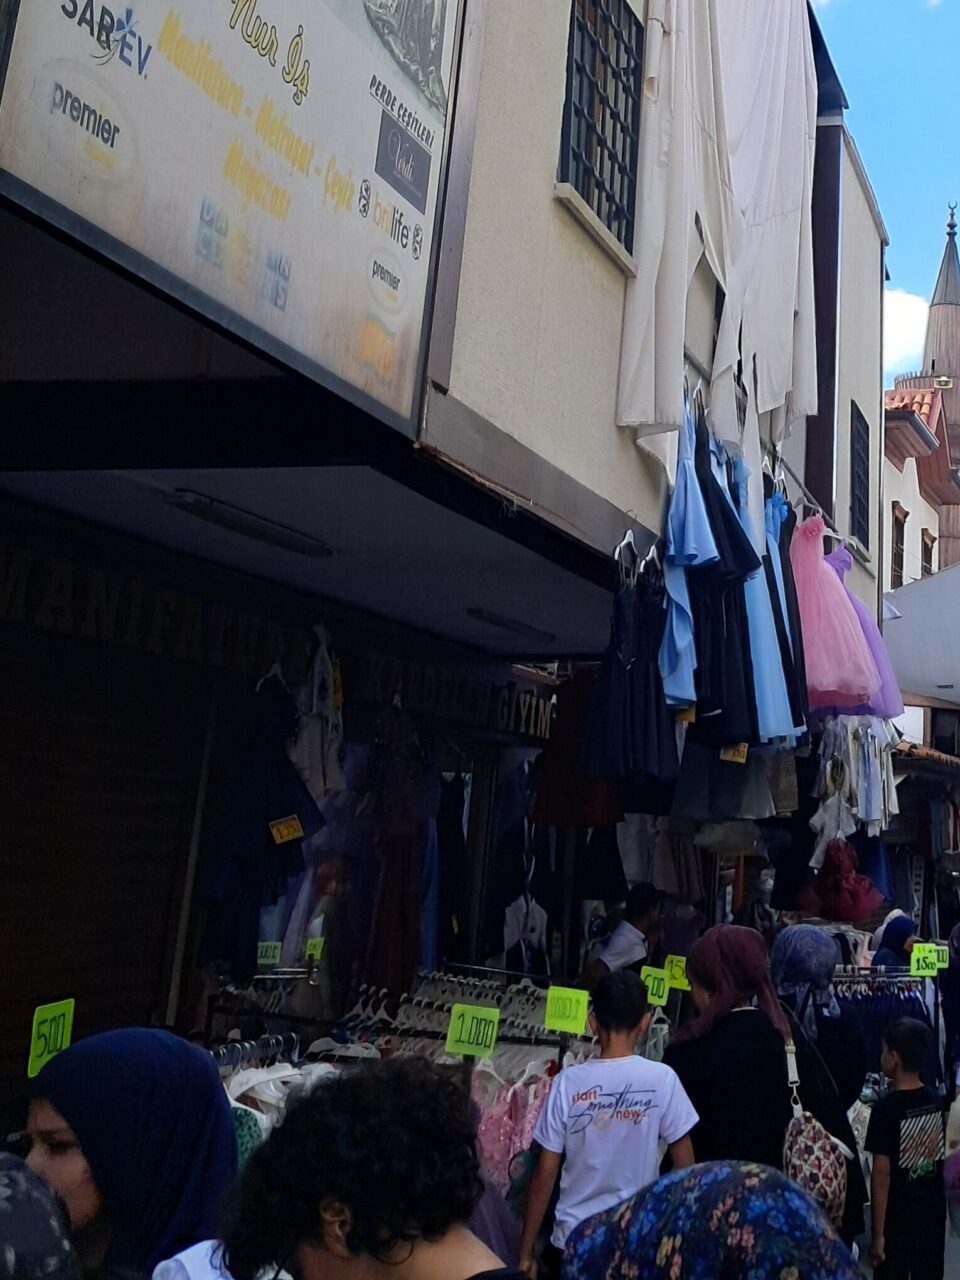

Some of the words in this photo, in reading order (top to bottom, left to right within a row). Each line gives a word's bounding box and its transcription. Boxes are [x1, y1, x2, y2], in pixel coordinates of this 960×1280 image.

[368, 74, 398, 113] PERDE
[50, 81, 120, 149] premier
[371, 259, 401, 292] premier
